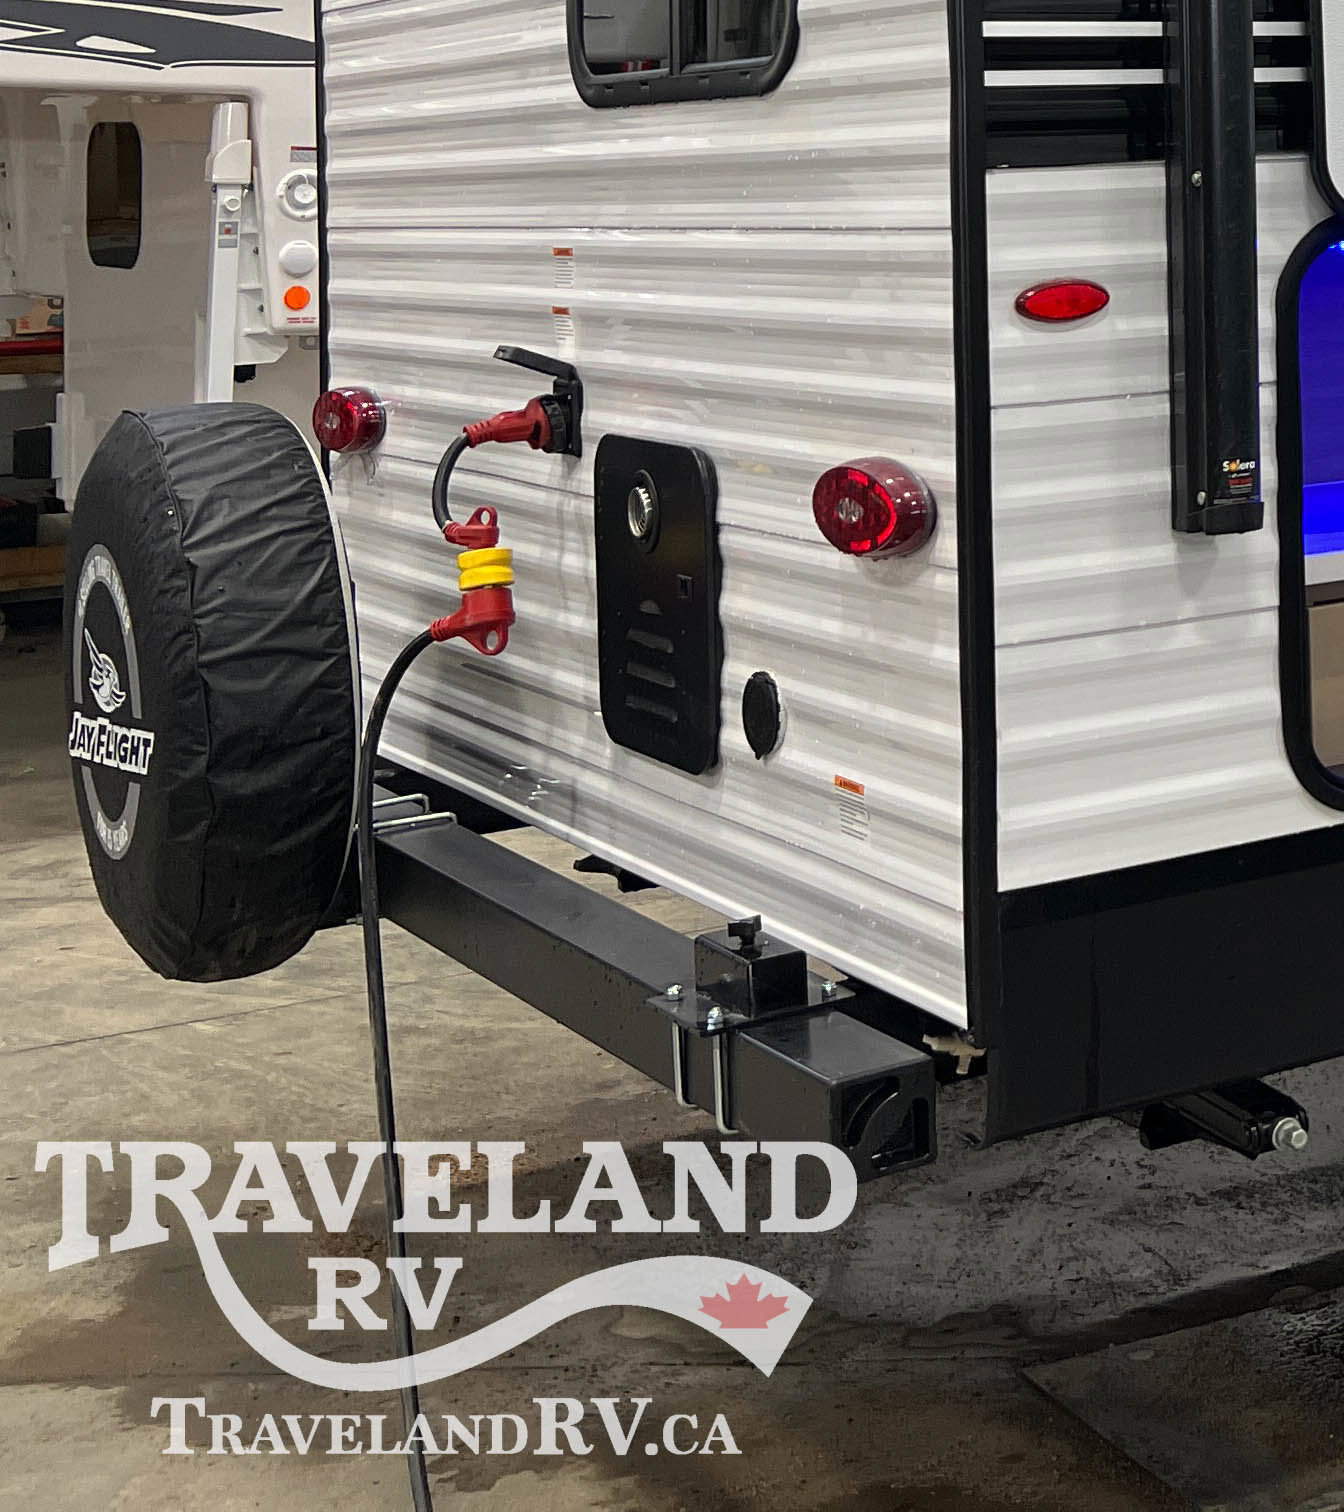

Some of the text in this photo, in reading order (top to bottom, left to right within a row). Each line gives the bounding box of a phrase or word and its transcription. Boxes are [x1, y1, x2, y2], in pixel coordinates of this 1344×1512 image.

[1222, 459, 1256, 472] Solera
[69, 712, 154, 774] JAY FLIGHT
